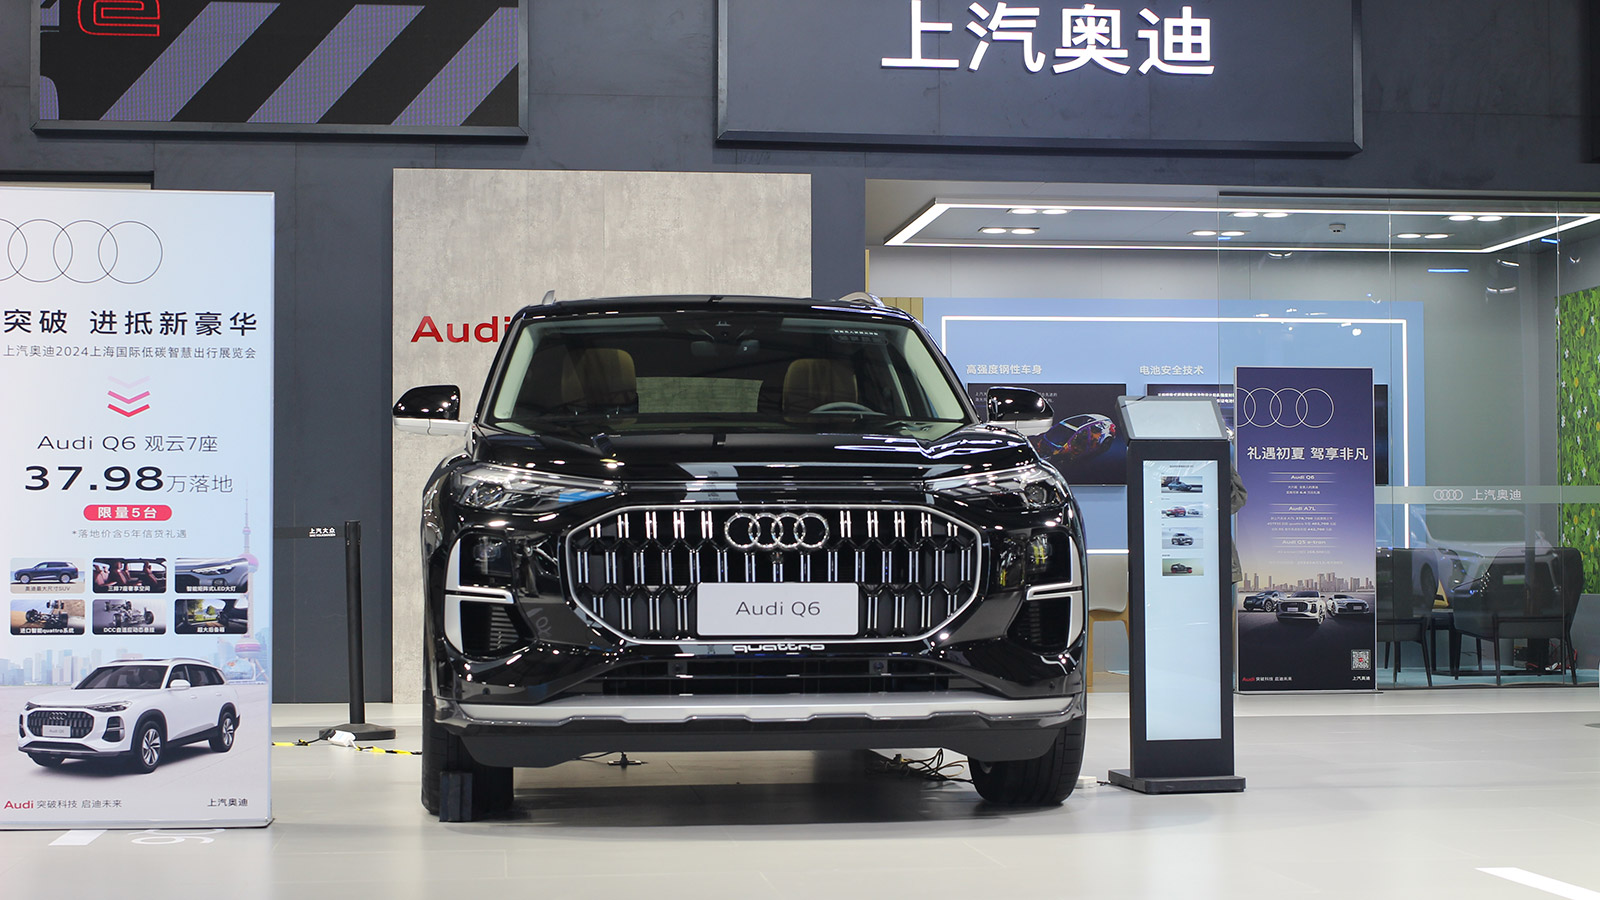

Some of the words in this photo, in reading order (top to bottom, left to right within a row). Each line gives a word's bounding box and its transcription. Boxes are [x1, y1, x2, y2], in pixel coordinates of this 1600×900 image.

[881, 0, 1215, 75] 上汽奥迪
[3, 309, 68, 334] 突破
[89, 311, 258, 336] 进抵新豪华
[3, 345, 257, 359] 上汽奥迪2024上海国际低碳智慧出行展览会
[966, 364, 1042, 376] 高强度钢性车身
[1139, 365, 1204, 376] 电池安全技术
[37, 436, 93, 450] Audi
[102, 436, 136, 451] Q6
[144, 435, 218, 452] 观云7座
[1247, 446, 1305, 460] 礼遇初夏
[1310, 447, 1369, 461] 驾享非凡
[24, 466, 233, 493] 37.98万落地
[1472, 489, 1521, 501] 上汽奥迪
[97, 507, 158, 519] 限量5台
[735, 601, 784, 616] Audi
[791, 601, 821, 617] Q6
[732, 643, 825, 652] quattro
[4, 800, 34, 809] Audi
[37, 799, 78, 809] 突破科技
[81, 799, 123, 809] 启迪未来
[207, 798, 248, 808] 上汽奥迪
